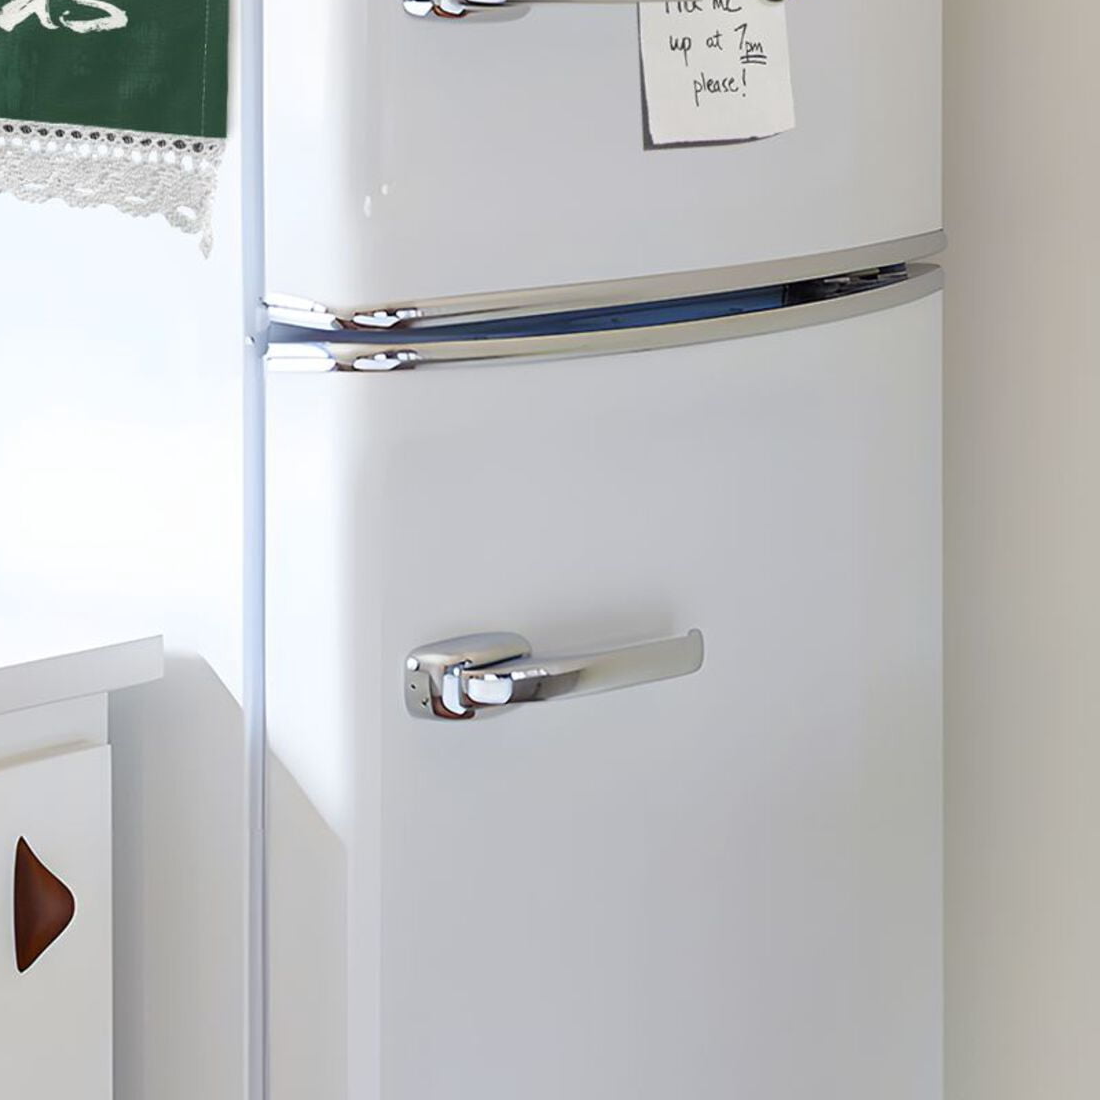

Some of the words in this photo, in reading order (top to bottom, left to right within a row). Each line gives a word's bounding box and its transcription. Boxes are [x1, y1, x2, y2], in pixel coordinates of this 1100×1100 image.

[669, 35, 692, 67] up
[705, 30, 723, 51] at
[734, 23, 767, 62] 7pm
[693, 68, 747, 107] please!
